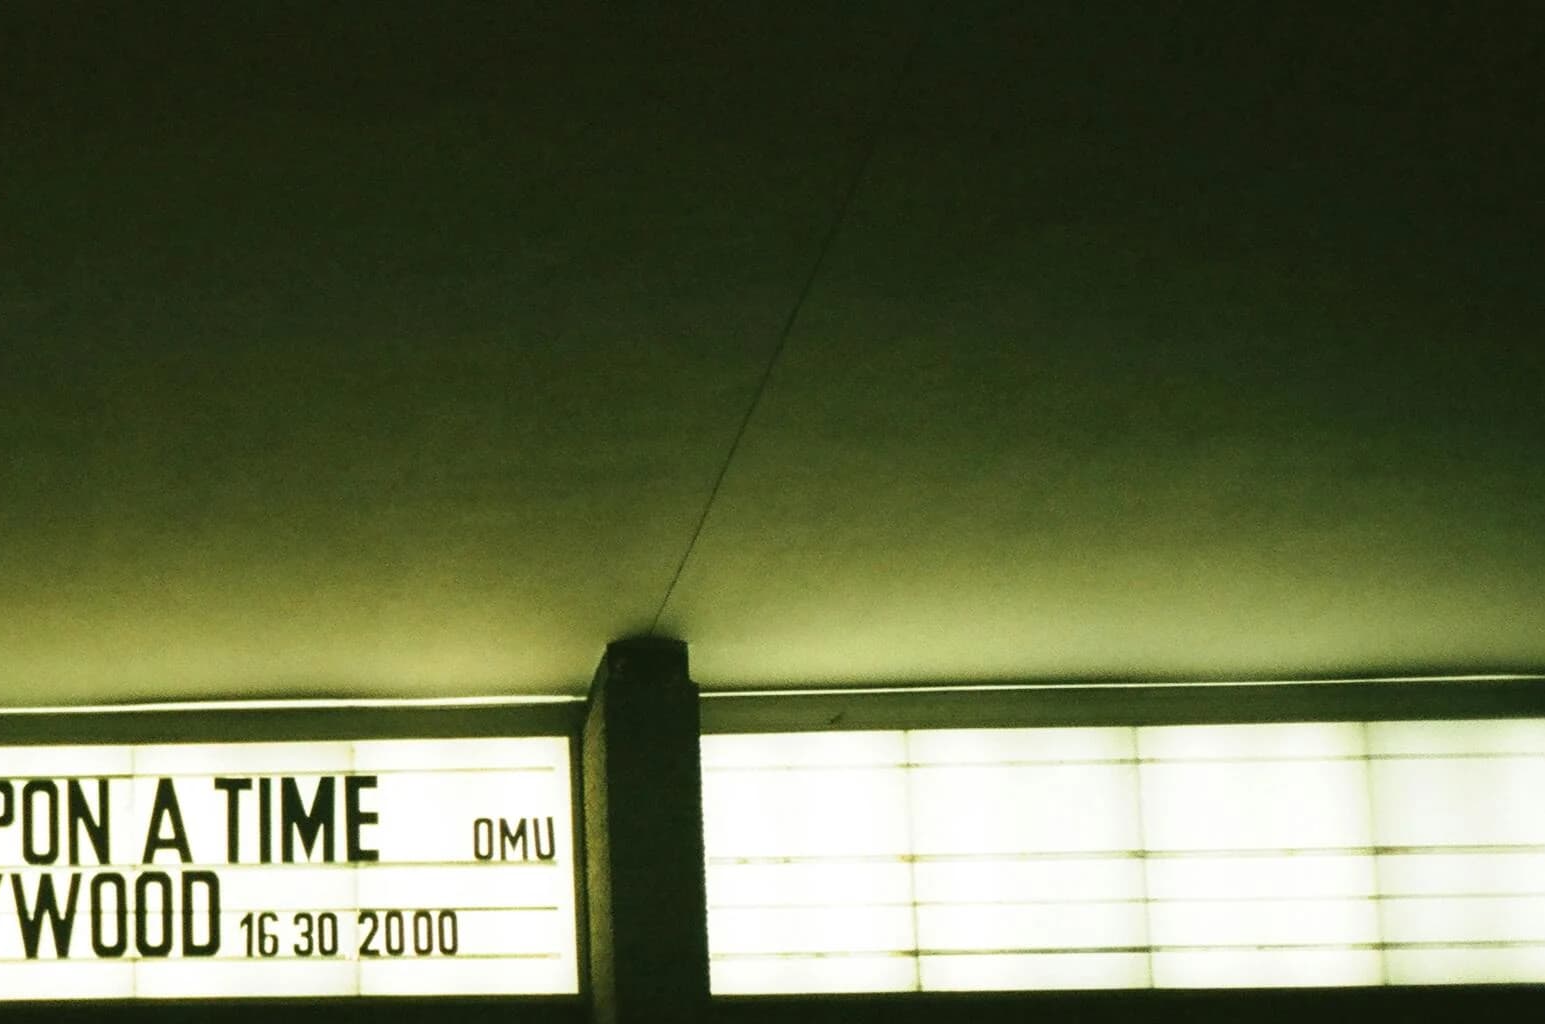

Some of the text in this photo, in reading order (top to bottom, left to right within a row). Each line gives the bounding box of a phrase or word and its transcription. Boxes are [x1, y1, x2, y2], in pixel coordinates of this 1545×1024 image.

[144, 779, 192, 863] A
[215, 776, 379, 863] TIME
[474, 818, 555, 860] OMU
[358, 911, 457, 956] 2000
